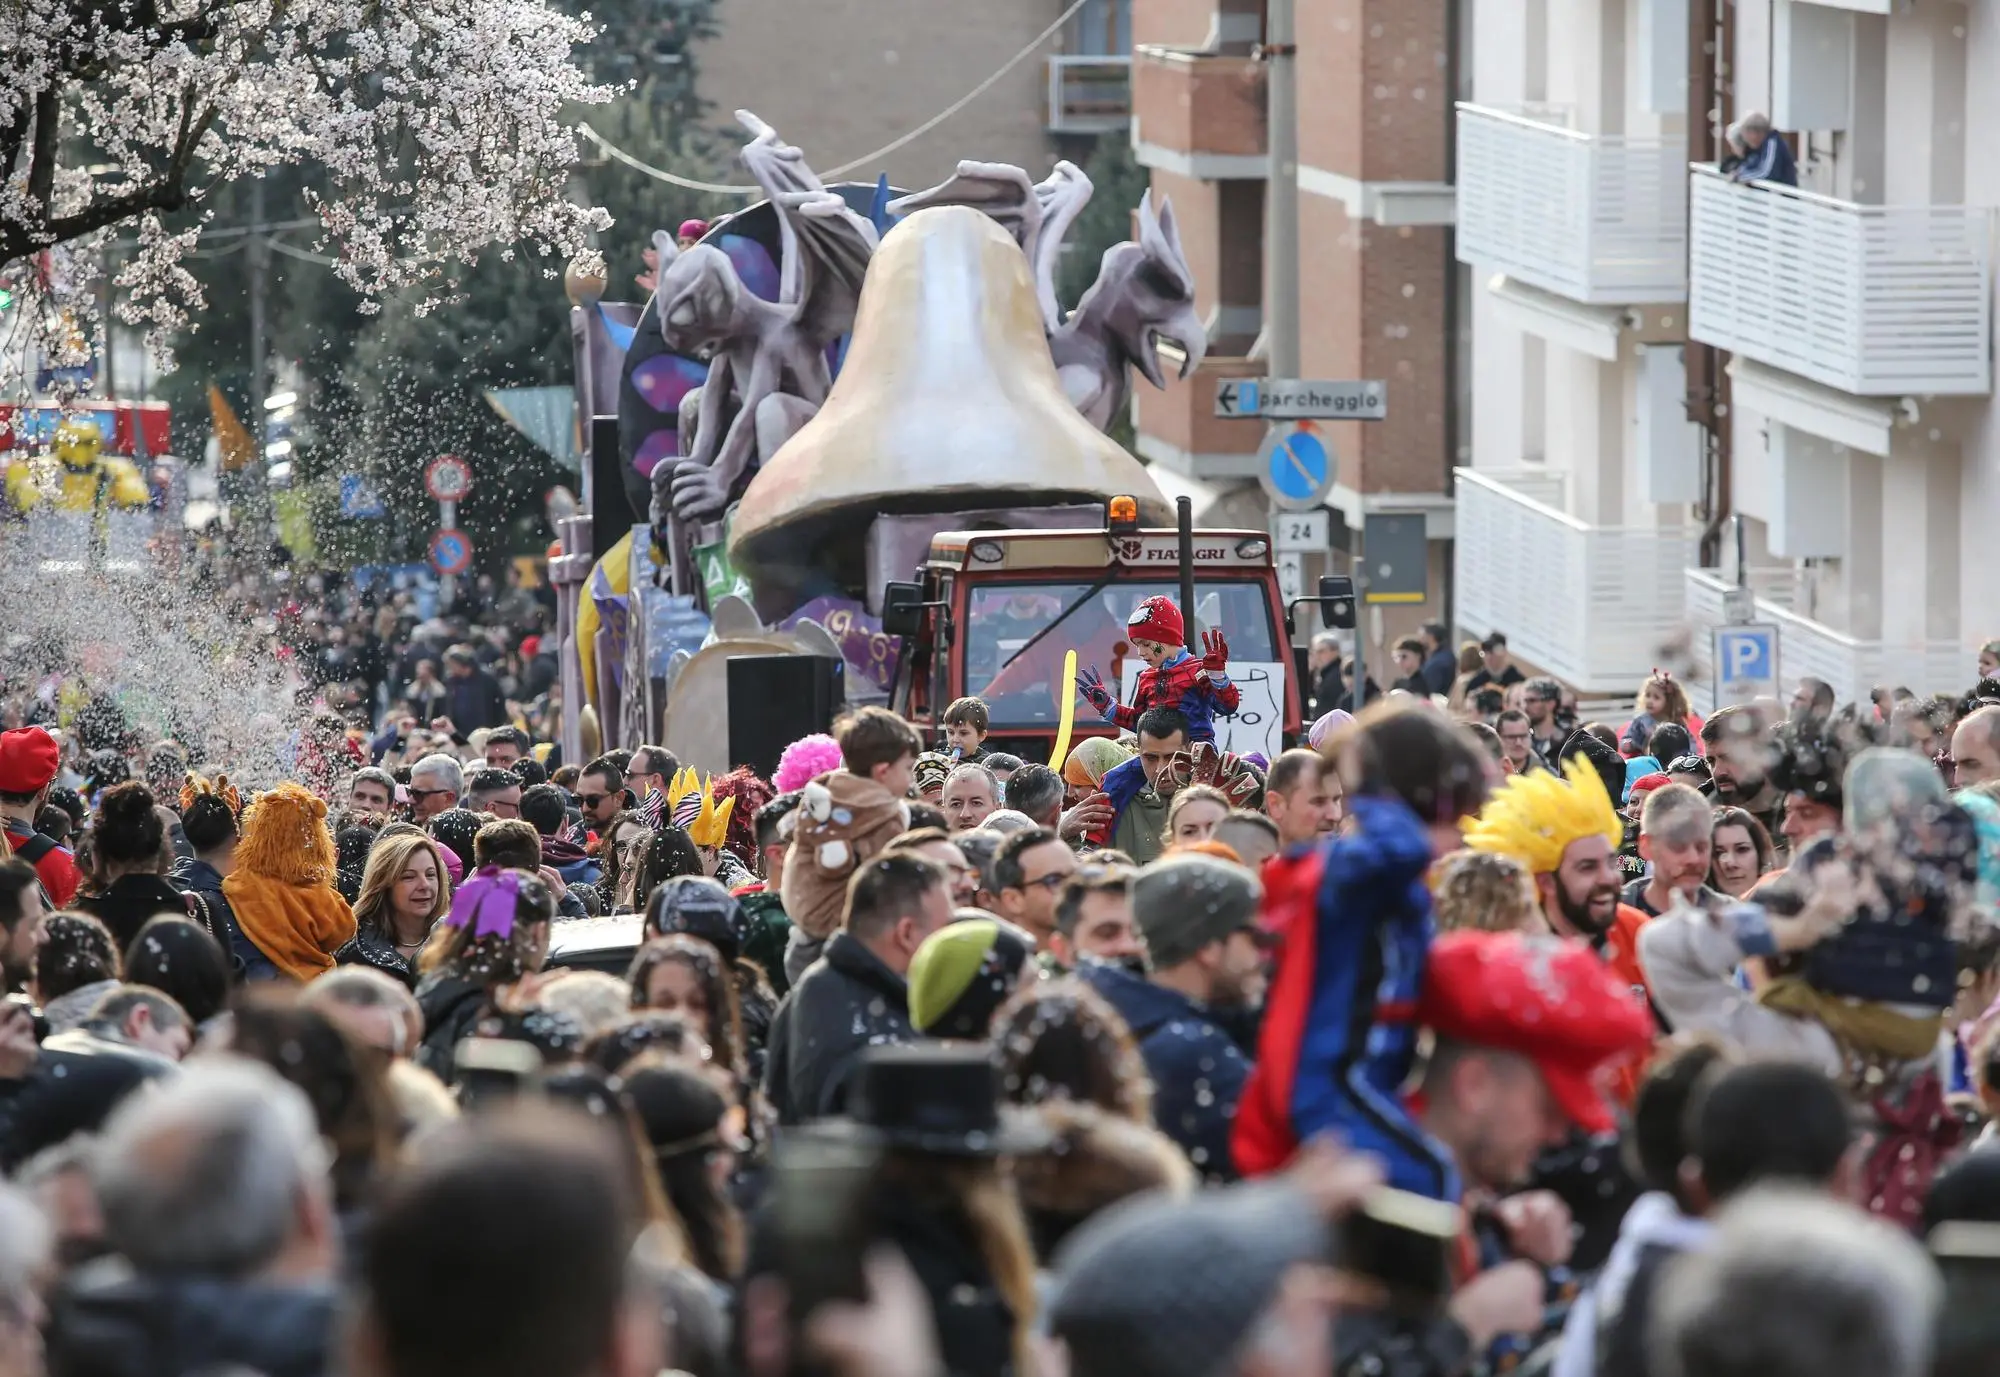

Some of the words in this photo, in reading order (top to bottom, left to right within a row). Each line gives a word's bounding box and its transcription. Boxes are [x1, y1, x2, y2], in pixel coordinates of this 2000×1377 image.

[1261, 390, 1378, 411] parcheggio
[1290, 523, 1311, 540] 24
[1147, 549, 1226, 560] FIAGRI
[1731, 637, 1760, 675] P
